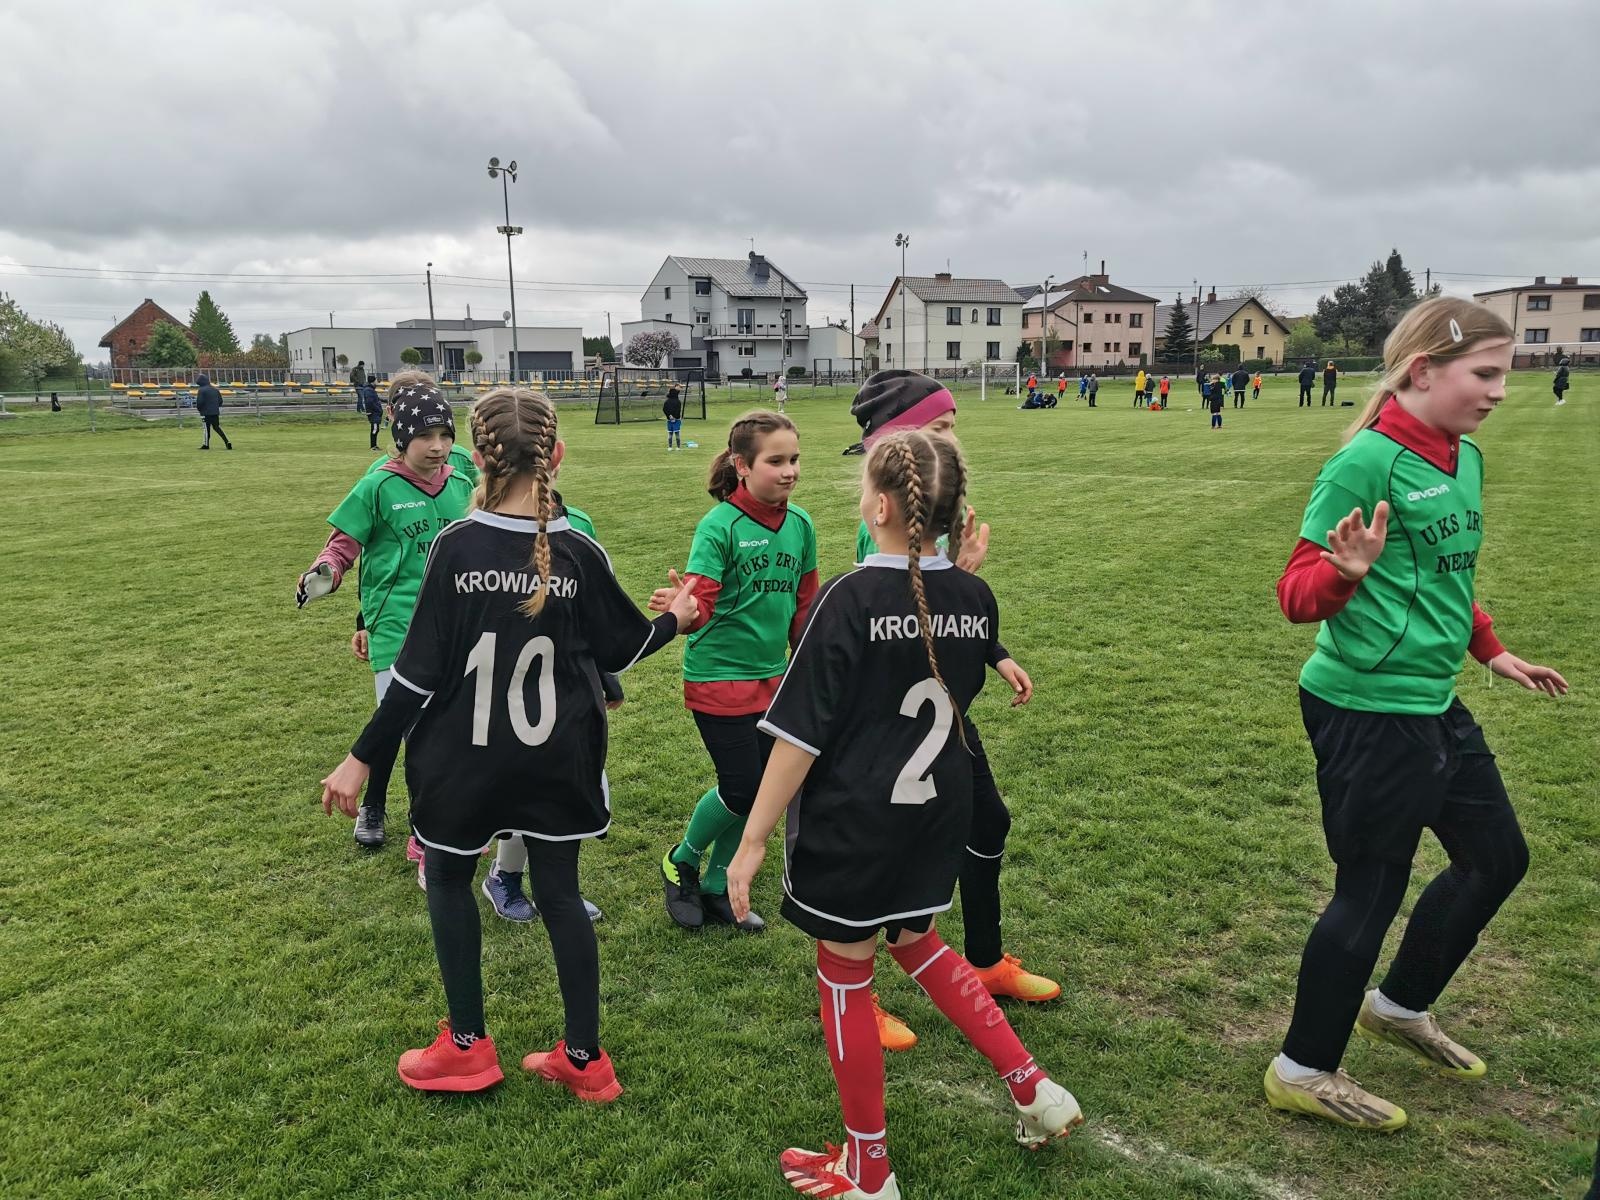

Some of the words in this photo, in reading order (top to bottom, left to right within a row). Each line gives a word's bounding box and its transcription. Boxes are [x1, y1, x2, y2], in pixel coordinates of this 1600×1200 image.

[1408, 484, 1450, 501] GIVOVA
[392, 500, 426, 511] GIVOVA
[403, 518, 429, 539] UKS
[1419, 513, 1460, 546] UKS
[739, 539, 769, 547] GIVOVA
[741, 554, 769, 576] UKS
[463, 632, 557, 747] 10
[890, 677, 955, 805] 2
